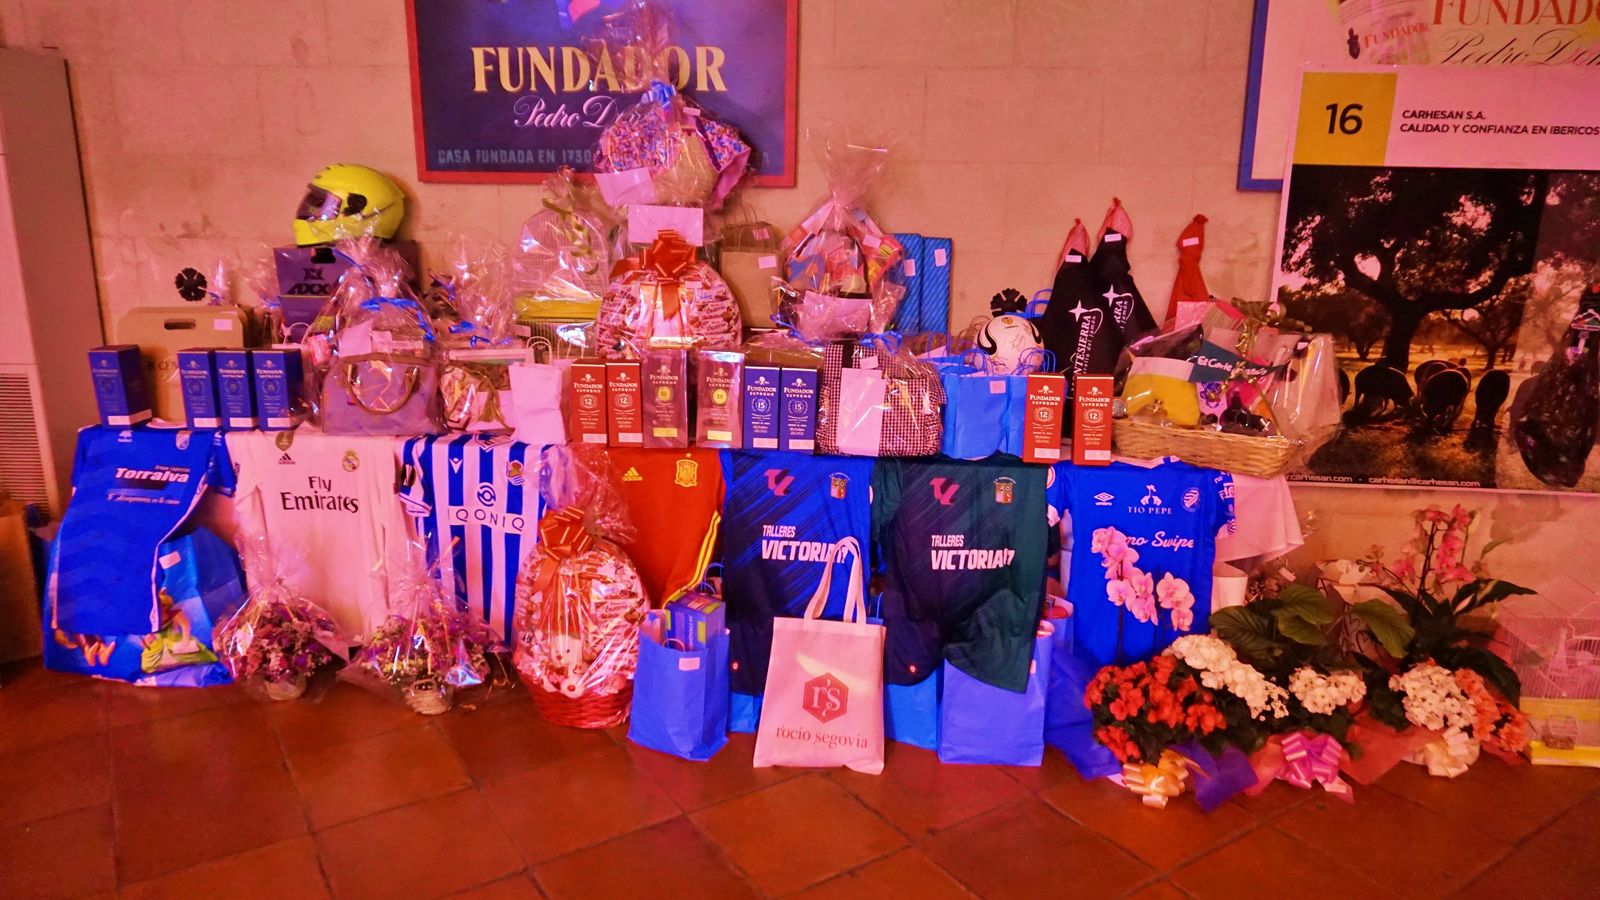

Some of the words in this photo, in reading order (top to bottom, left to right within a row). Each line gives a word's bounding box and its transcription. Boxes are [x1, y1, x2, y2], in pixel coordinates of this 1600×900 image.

[513, 94, 581, 128] Pedro
[1402, 109, 1463, 120] CARHESAN
[1466, 110, 1486, 121] S.A.
[1325, 102, 1364, 136] 16
[1399, 123, 1450, 133] CALIDAD
[1452, 123, 1461, 134] Y
[1462, 124, 1529, 135] CONFIANZA
[1531, 125, 1547, 135] EN
[1549, 126, 1600, 136] IBERICOS
[438, 149, 471, 164] CASA
[476, 149, 534, 164] FUNDADA
[538, 149, 555, 164] EN
[747, 384, 777, 392] FUNDADOR
[783, 386, 814, 395] FUNDADOR
[1029, 394, 1061, 402] FUNDADOR
[308, 476, 332, 492] Fly
[280, 491, 359, 513] Emirates
[448, 508, 525, 532] IQONIQ
[762, 524, 796, 538] TALLERES
[931, 534, 965, 547] TALLERES
[1152, 530, 1195, 552] Swipe
